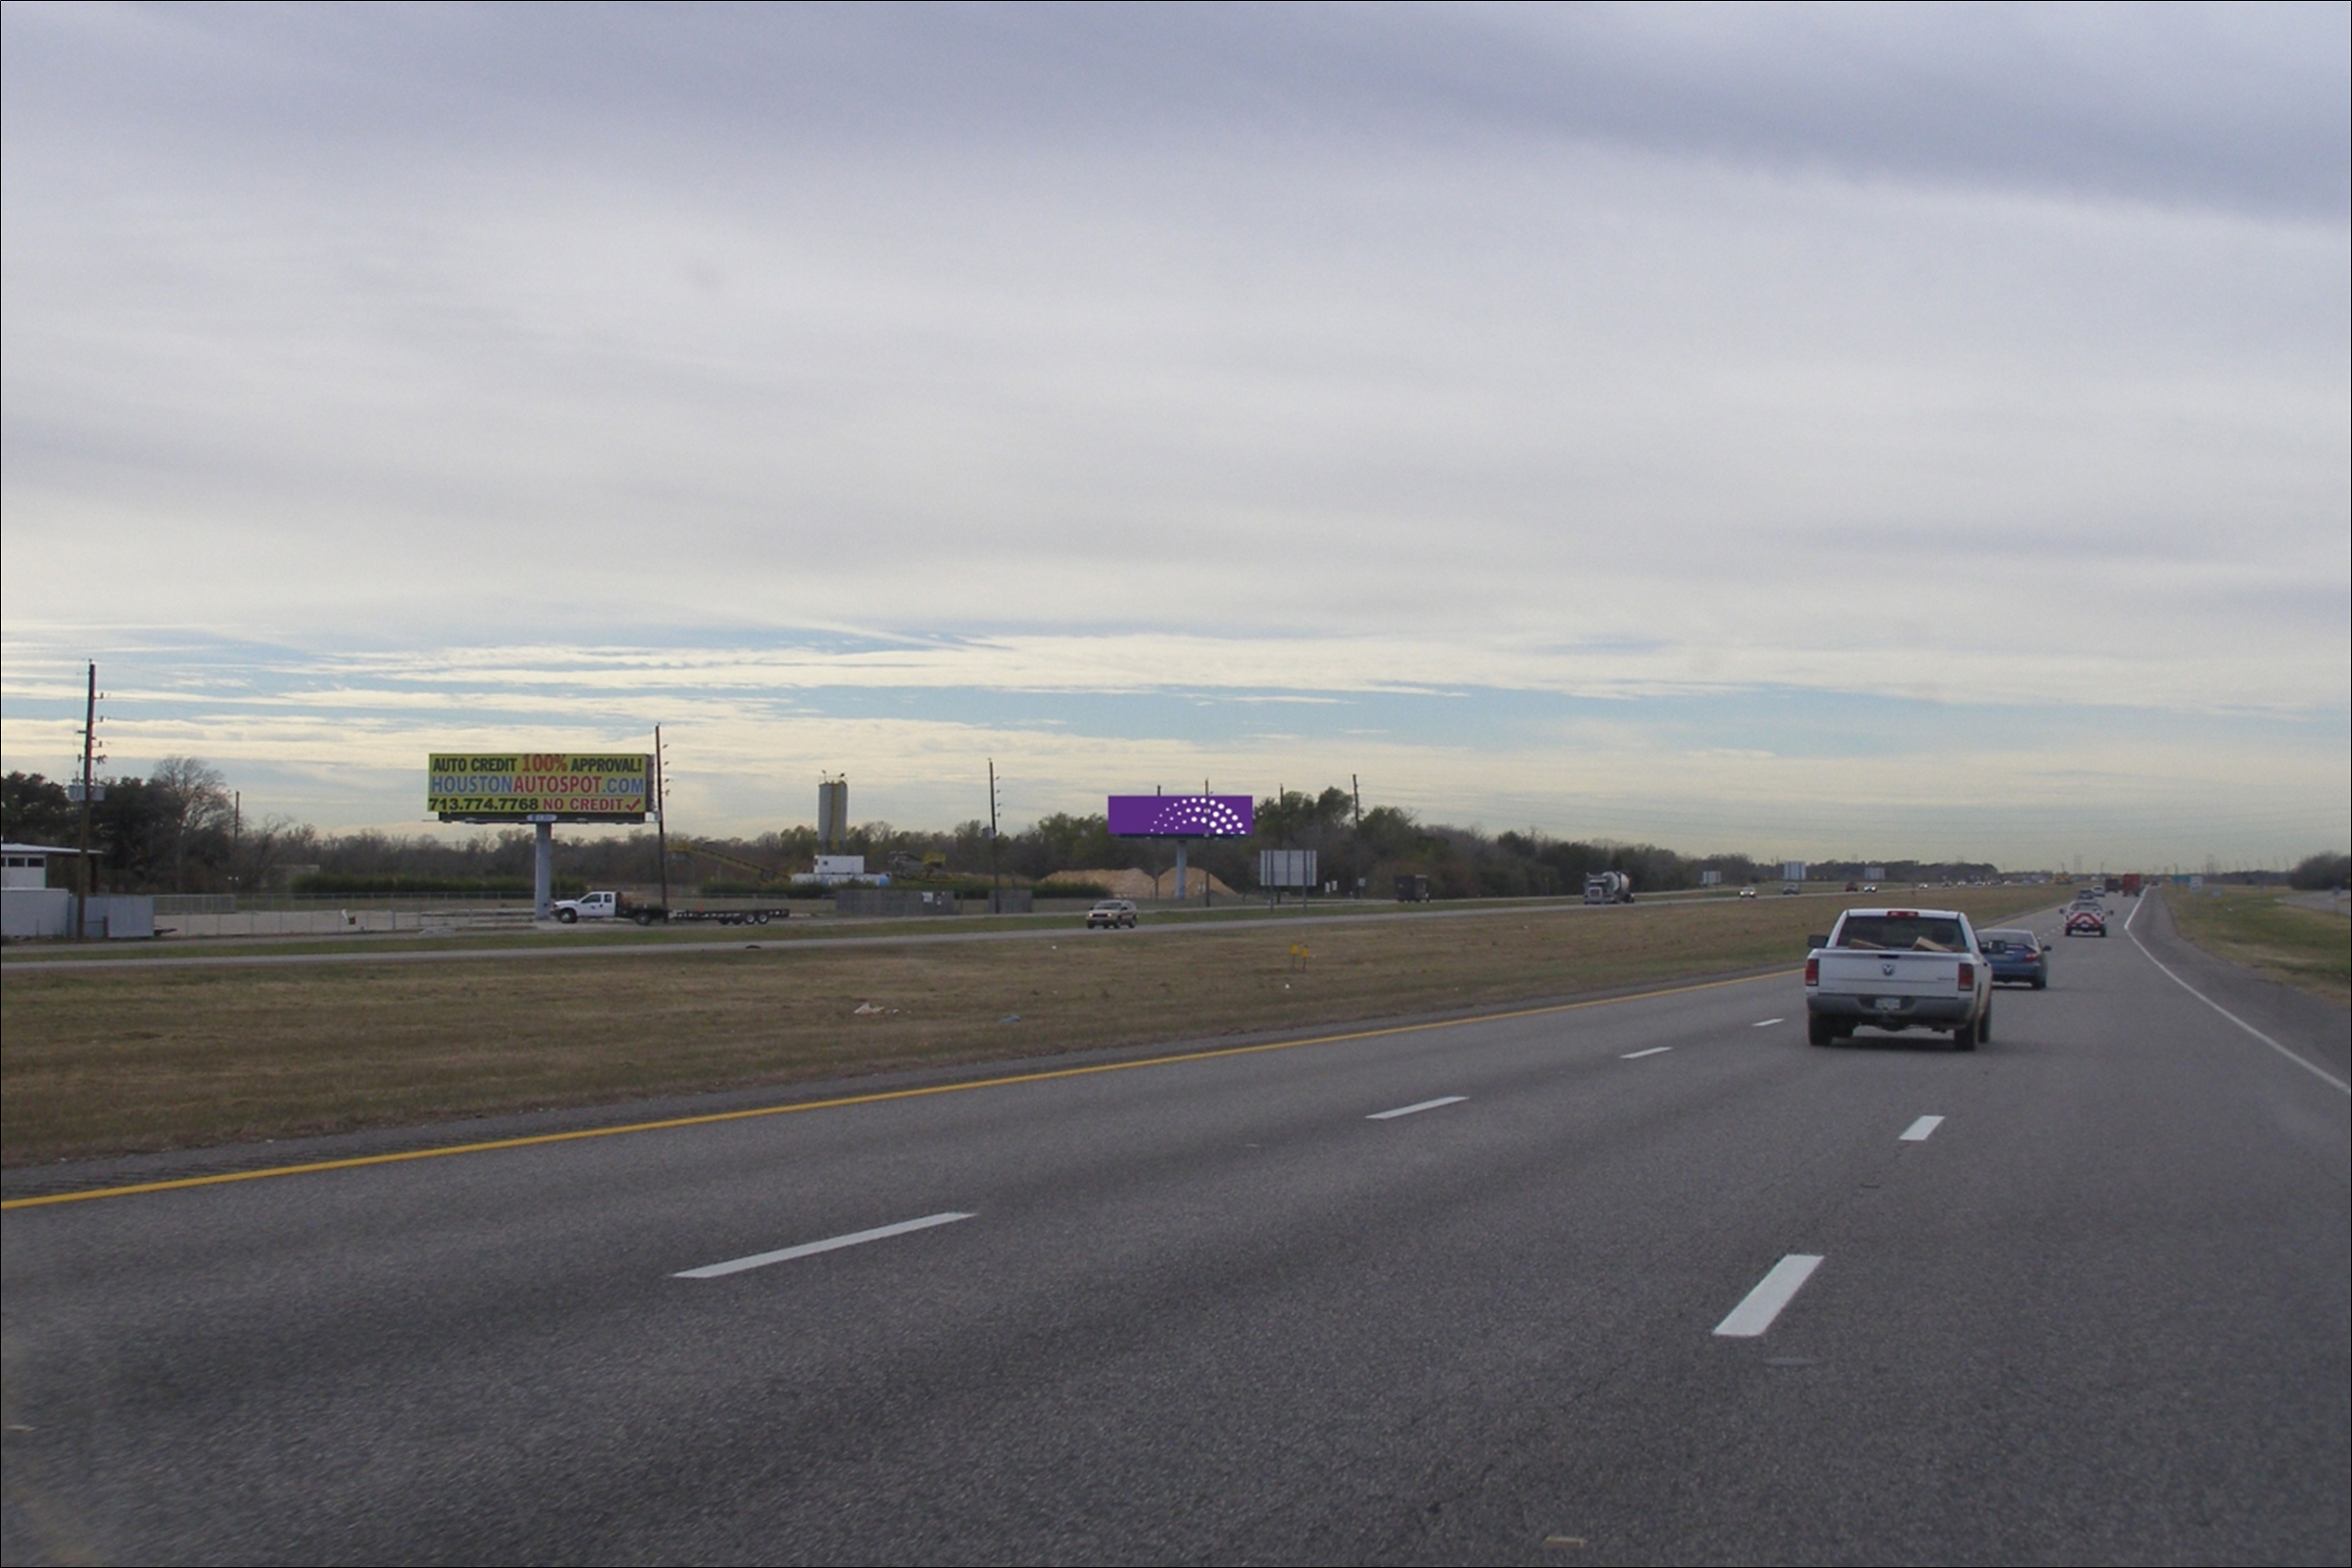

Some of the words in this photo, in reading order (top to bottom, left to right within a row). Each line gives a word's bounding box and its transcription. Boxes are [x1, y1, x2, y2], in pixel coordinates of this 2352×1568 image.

[433, 758, 466, 772] AUTO
[470, 758, 517, 772] CREDIT
[521, 754, 567, 772] 100%
[570, 758, 642, 772] APPROVAL!
[431, 775, 644, 794] HOUSTONAUTOSPOT.COM
[429, 798, 539, 810] 713.774.7768
[543, 798, 564, 810] NO
[569, 798, 624, 810] CREDIT
